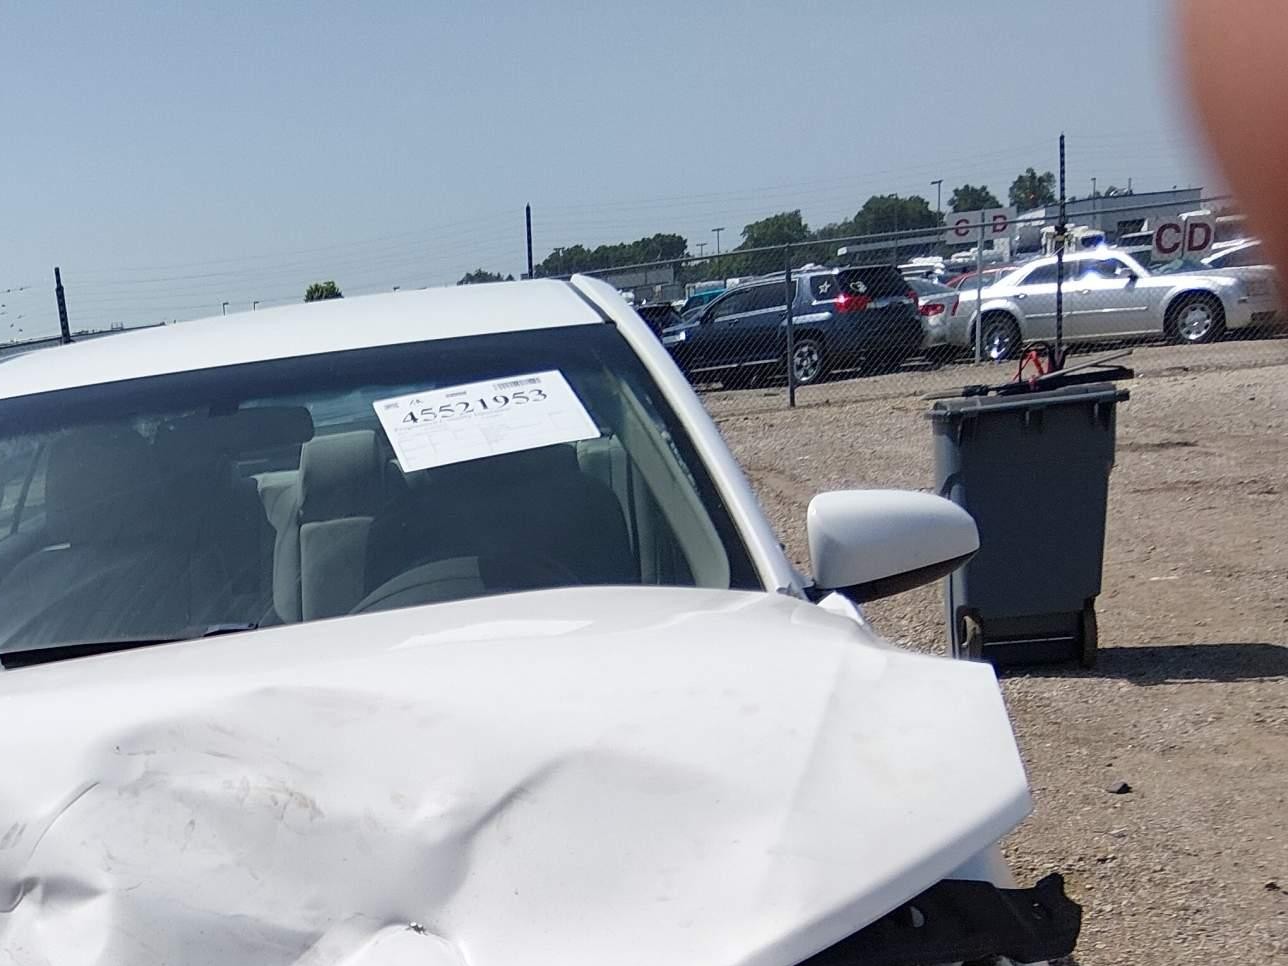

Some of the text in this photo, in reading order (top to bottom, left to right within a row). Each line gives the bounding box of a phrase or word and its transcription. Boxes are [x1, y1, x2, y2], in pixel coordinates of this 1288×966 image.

[954, 215, 1008, 237] C D
[402, 389, 547, 424] 45521953
